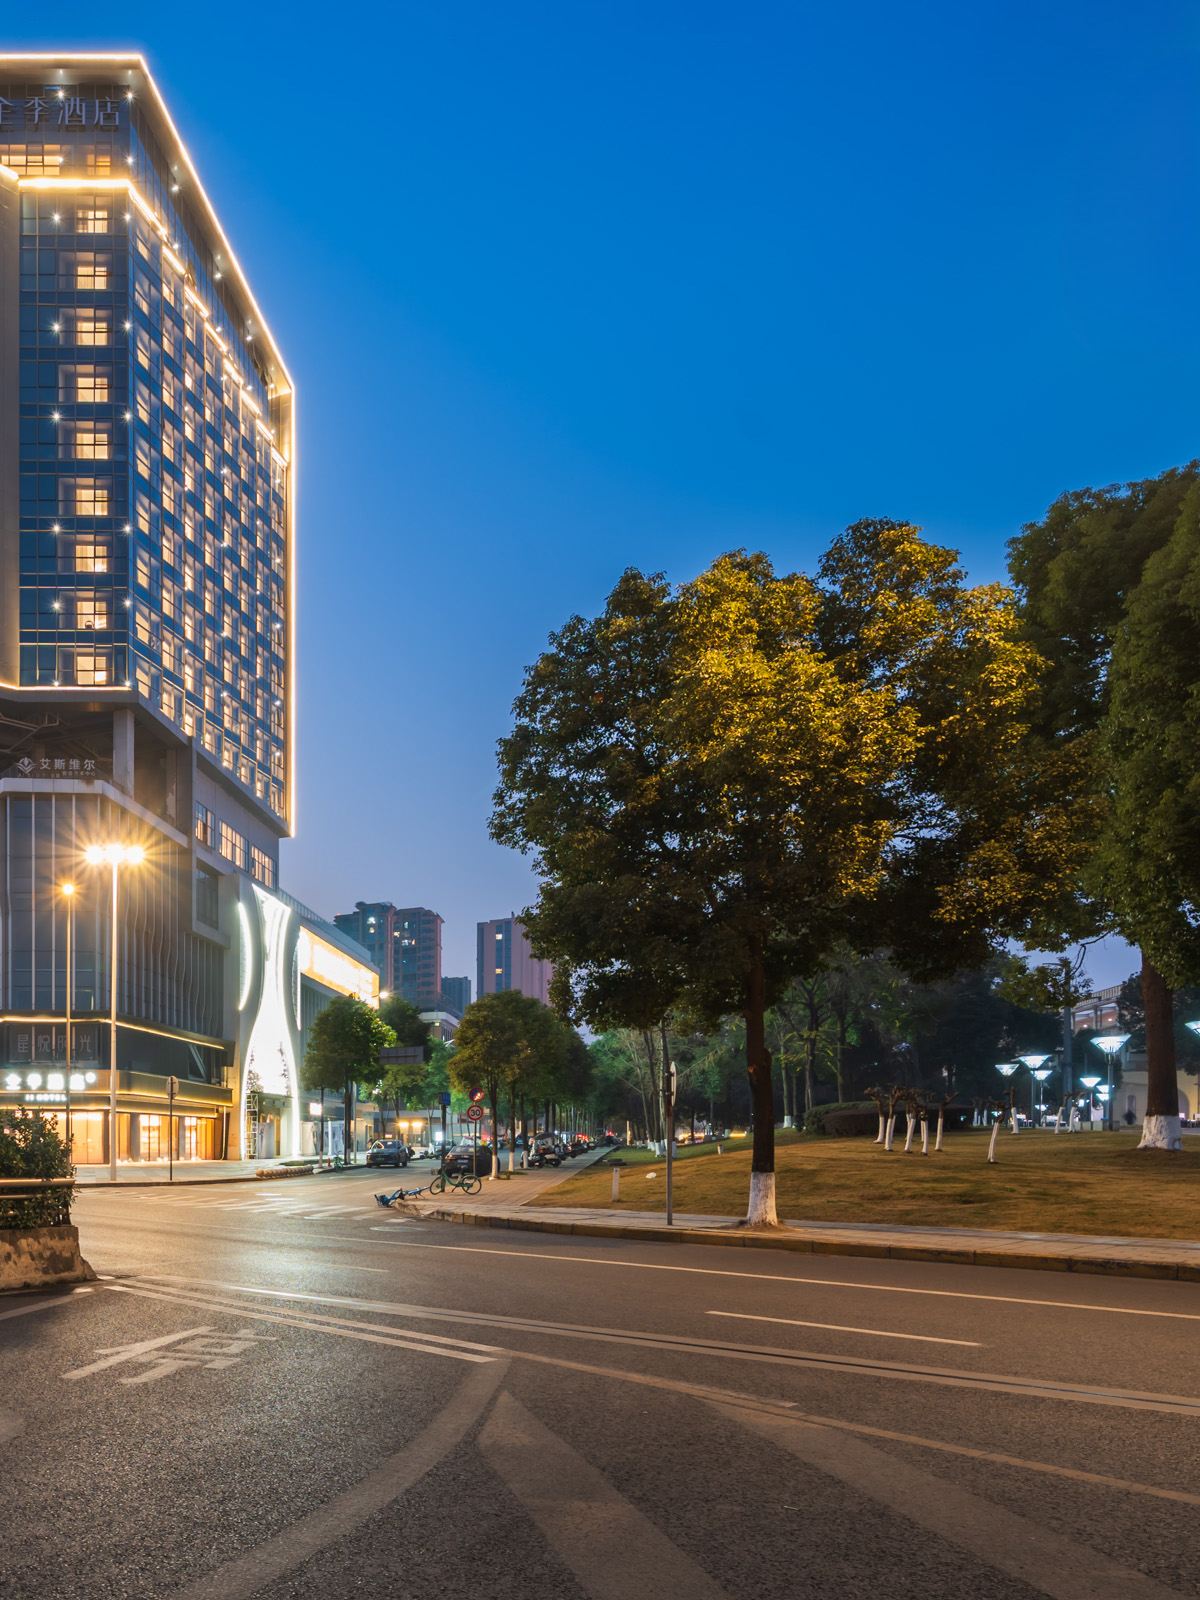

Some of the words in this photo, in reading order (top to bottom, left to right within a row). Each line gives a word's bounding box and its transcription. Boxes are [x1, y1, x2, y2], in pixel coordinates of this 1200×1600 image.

[39, 758, 96, 771] 艾斯维尔
[470, 1109, 481, 1117] 30
[60, 1326, 278, 1384] 停
